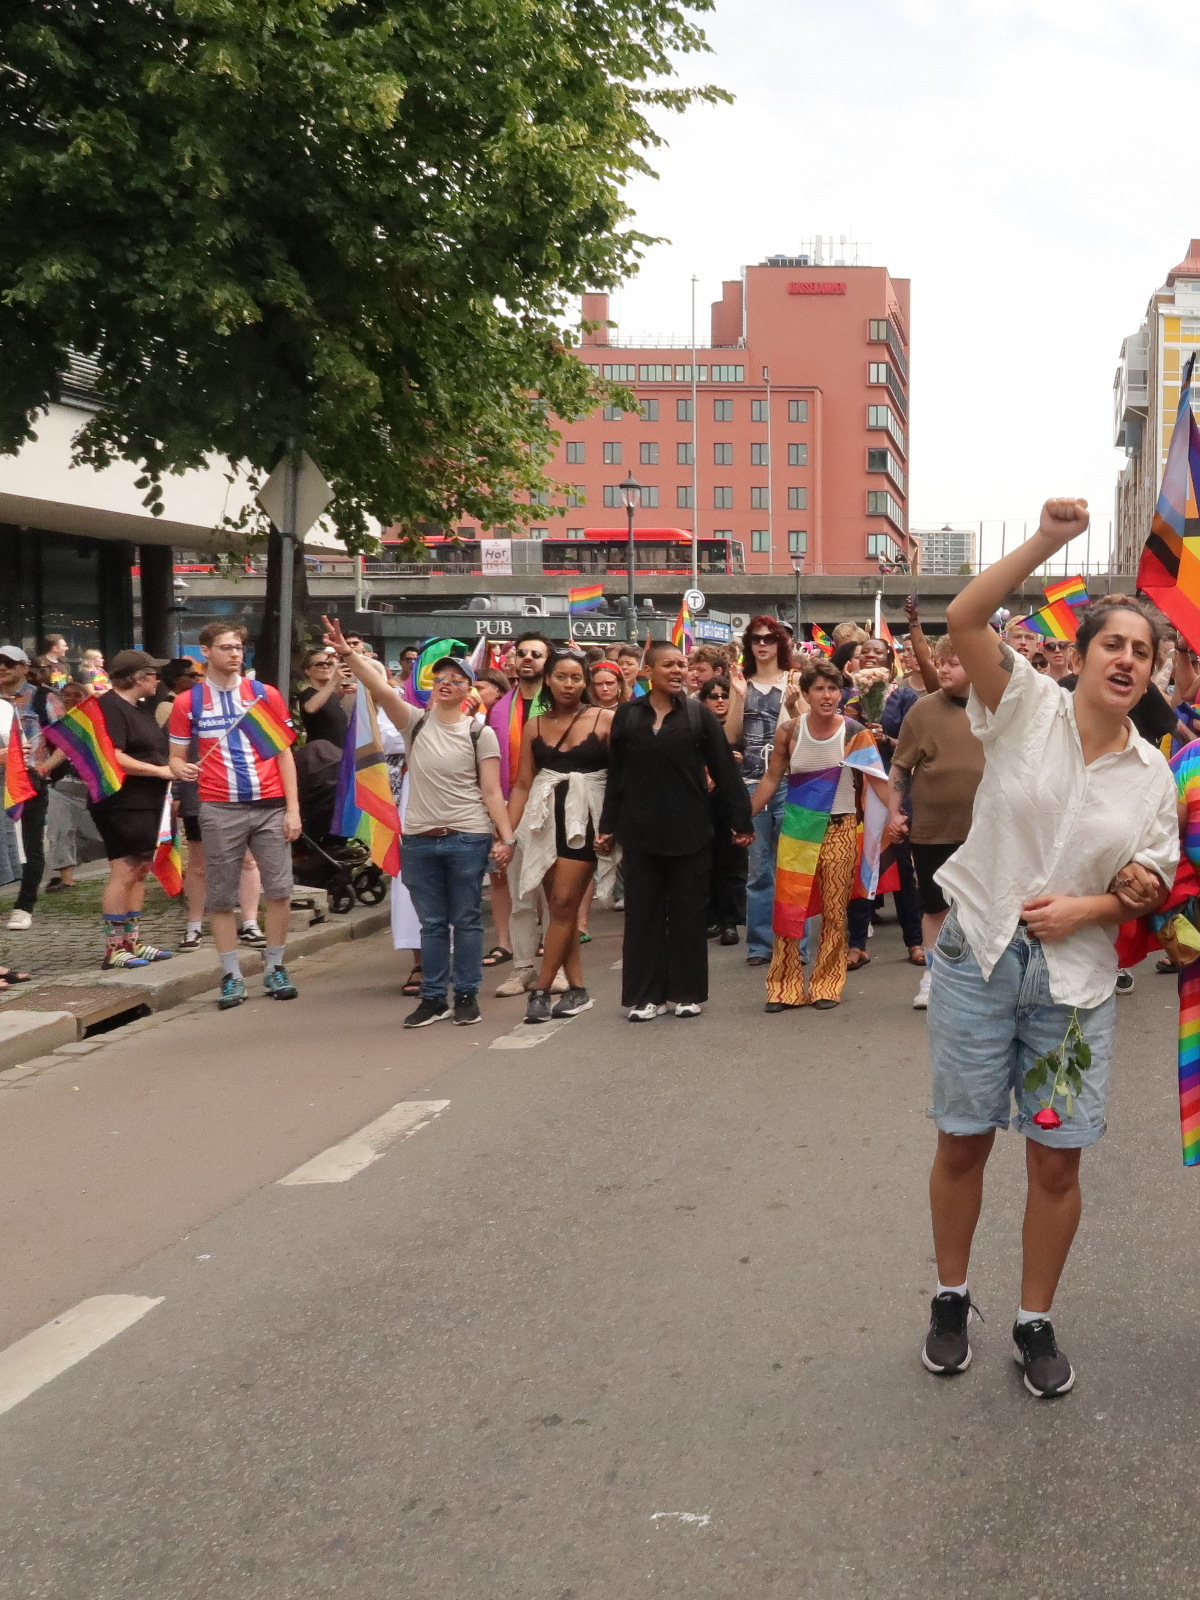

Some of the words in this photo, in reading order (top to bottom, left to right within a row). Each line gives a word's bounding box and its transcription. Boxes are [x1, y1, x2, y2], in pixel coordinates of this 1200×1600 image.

[690, 596, 700, 607] T
[475, 620, 513, 635] PUB
[572, 621, 617, 637] CAFE
